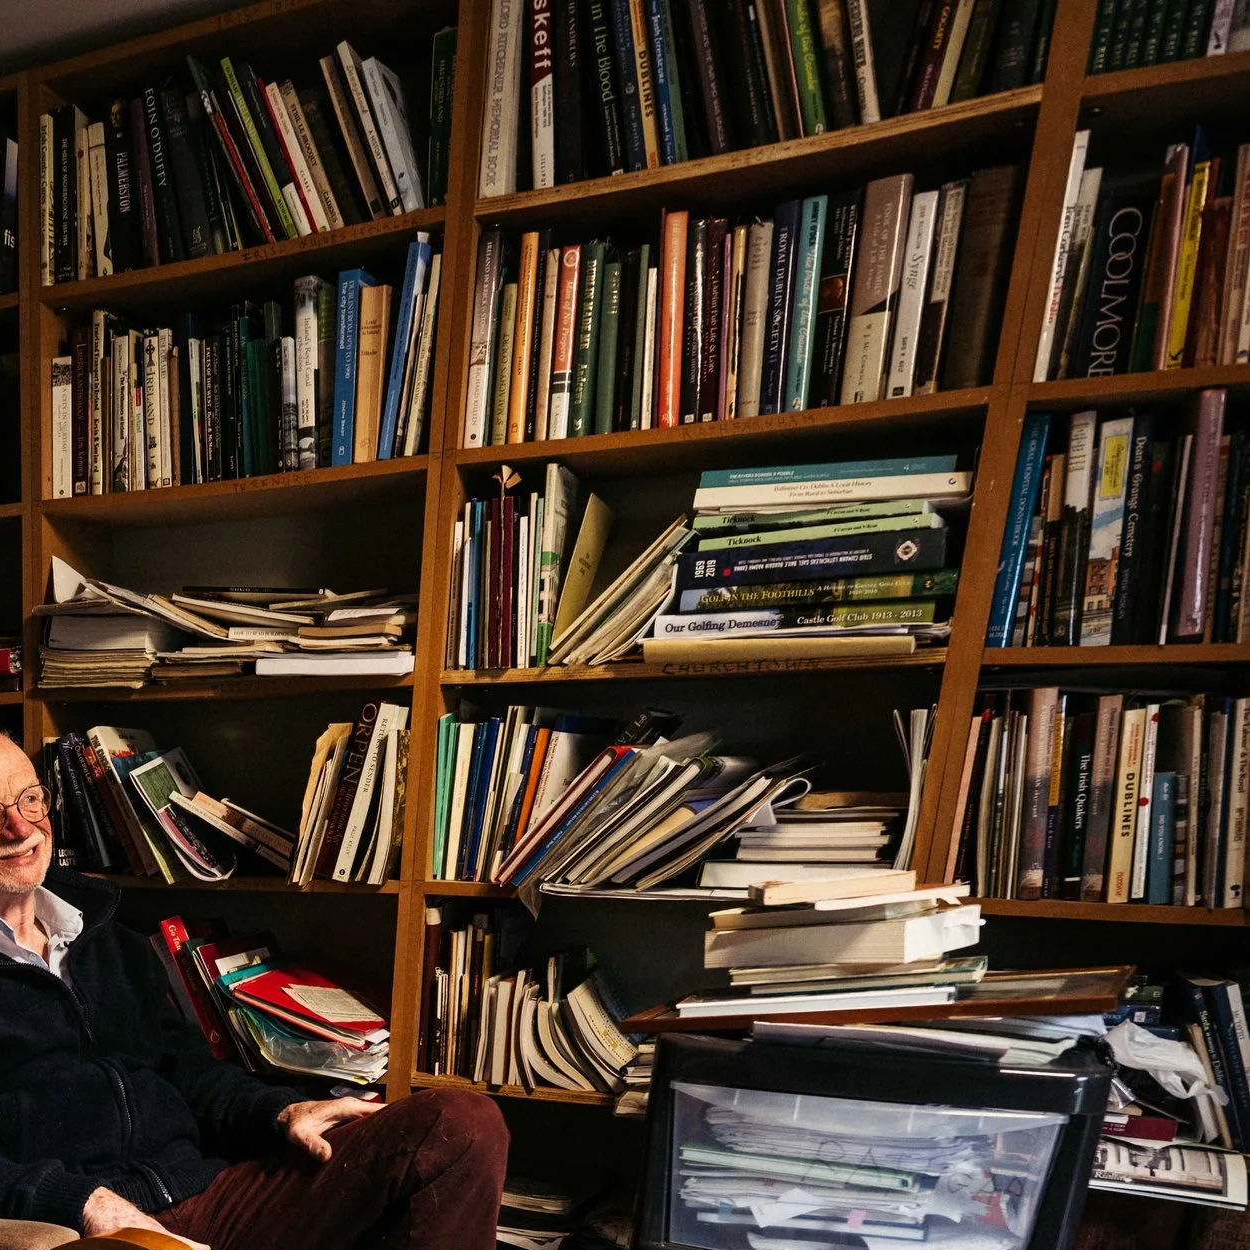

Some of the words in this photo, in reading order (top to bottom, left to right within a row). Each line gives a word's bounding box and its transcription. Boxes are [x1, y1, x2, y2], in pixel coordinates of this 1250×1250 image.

[596, 55, 615, 102] Blood
[638, 50, 653, 117] DUBLINES
[144, 87, 157, 124] EOIN
[488, 97, 502, 153] MEMORIAL
[149, 126, 166, 187] O'DUFFY
[486, 155, 498, 186] BOOK
[116, 151, 130, 212] PALMERSTON
[777, 232, 788, 265] ROYAL
[584, 259, 597, 298] DUBLIN
[773, 267, 785, 306] DUBLIN
[905, 252, 924, 289] Synge
[1087, 207, 1143, 376] COOLMORE
[580, 300, 593, 330] MADE
[770, 308, 781, 351] SOCIETY
[579, 332, 589, 349] ME
[722, 515, 755, 523] Ticknock
[727, 535, 760, 545] Ticknock
[694, 560, 705, 578] 1969
[705, 559, 716, 577] 2019
[740, 591, 758, 600] THE
[761, 588, 814, 599] FOOTHILLS
[665, 623, 684, 632] Our
[687, 620, 725, 632] Golfing
[728, 617, 775, 628] Demesne
[796, 615, 824, 624] Castle
[826, 614, 845, 622] Golf
[847, 613, 868, 621] Club
[871, 611, 892, 619] 1913
[900, 609, 922, 618] 2013
[343, 703, 377, 785] ORPEN
[371, 751, 379, 761] TO
[1079, 751, 1091, 769] The
[363, 763, 375, 793] SENDER
[1077, 771, 1089, 791] Irish
[1072, 792, 1086, 829] Quakers
[1120, 772, 1135, 836] DUBLINES
